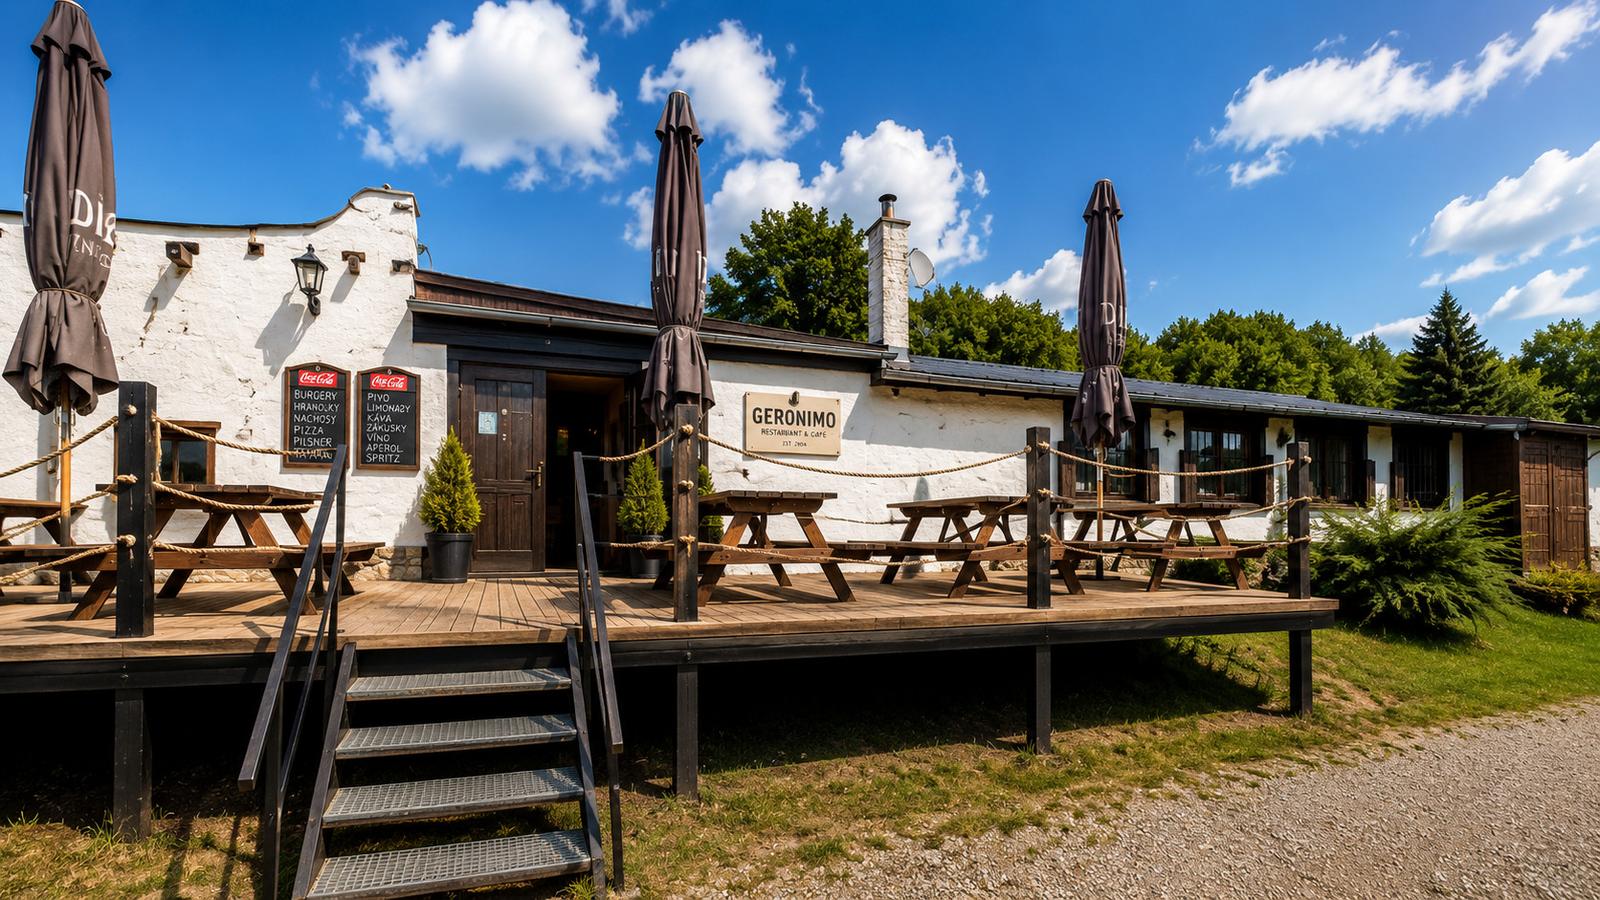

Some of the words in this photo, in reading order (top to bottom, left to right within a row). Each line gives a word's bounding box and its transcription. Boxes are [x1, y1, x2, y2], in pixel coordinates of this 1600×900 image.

[294, 389, 338, 400] BURGERY
[367, 392, 390, 402] PIVO
[293, 414, 337, 424] NACHOSY
[752, 407, 836, 428] GERONIMO
[293, 425, 324, 435] PIZZA
[293, 436, 332, 447] PILSNER
[366, 443, 404, 453] APEROL
[366, 453, 400, 463] SPRITZ
